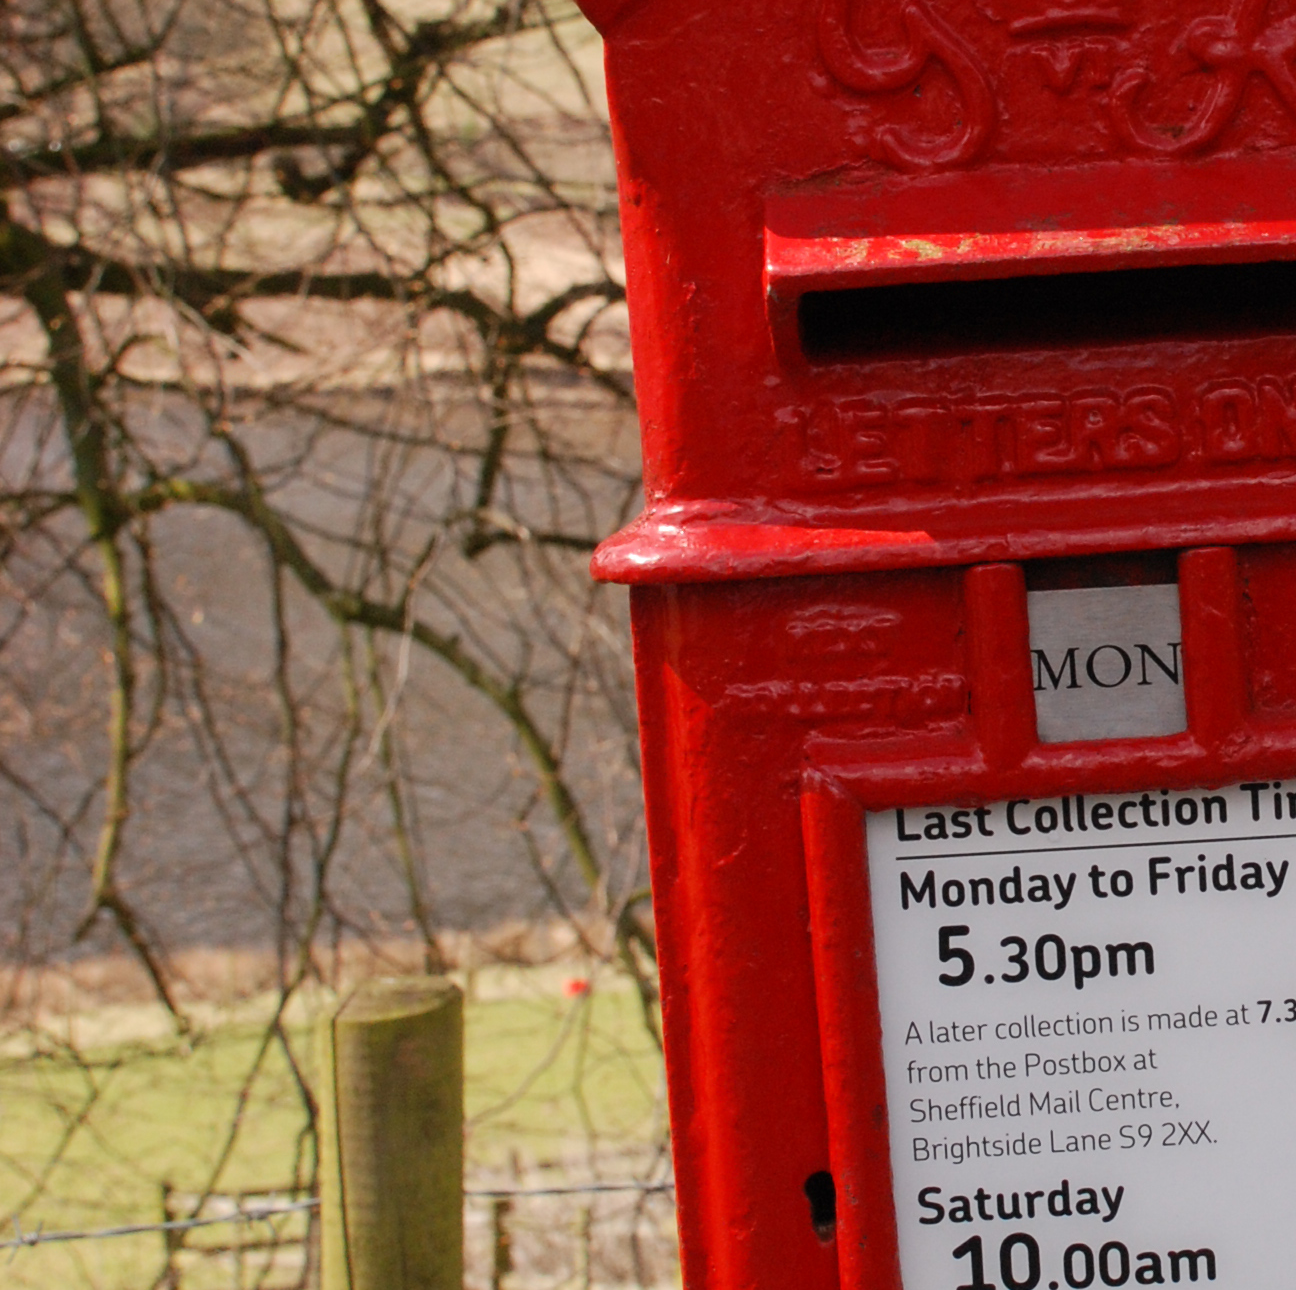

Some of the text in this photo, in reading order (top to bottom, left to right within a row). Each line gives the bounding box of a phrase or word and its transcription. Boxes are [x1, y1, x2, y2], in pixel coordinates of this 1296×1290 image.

[801, 384, 1180, 479] LETTERS
[1030, 642, 1182, 691] MON
[896, 808, 994, 841] Last
[1005, 789, 1228, 835] Collection
[899, 853, 1290, 911] Monday to Friday
[938, 924, 1155, 991] 5.30pm
[904, 1020, 923, 1046] A
[929, 1020, 988, 1044] later
[995, 1011, 1113, 1040] collection
[1121, 1009, 1140, 1033] is
[1147, 1004, 1218, 1031] made
[1225, 1004, 1251, 1026] at
[906, 1048, 1158, 1084] from the Postbox at
[909, 1087, 1180, 1123] Sheffield Mail Centre,
[912, 1120, 1218, 1165] Brightside Lane S9 2XX.
[917, 1179, 1125, 1225] Saturday
